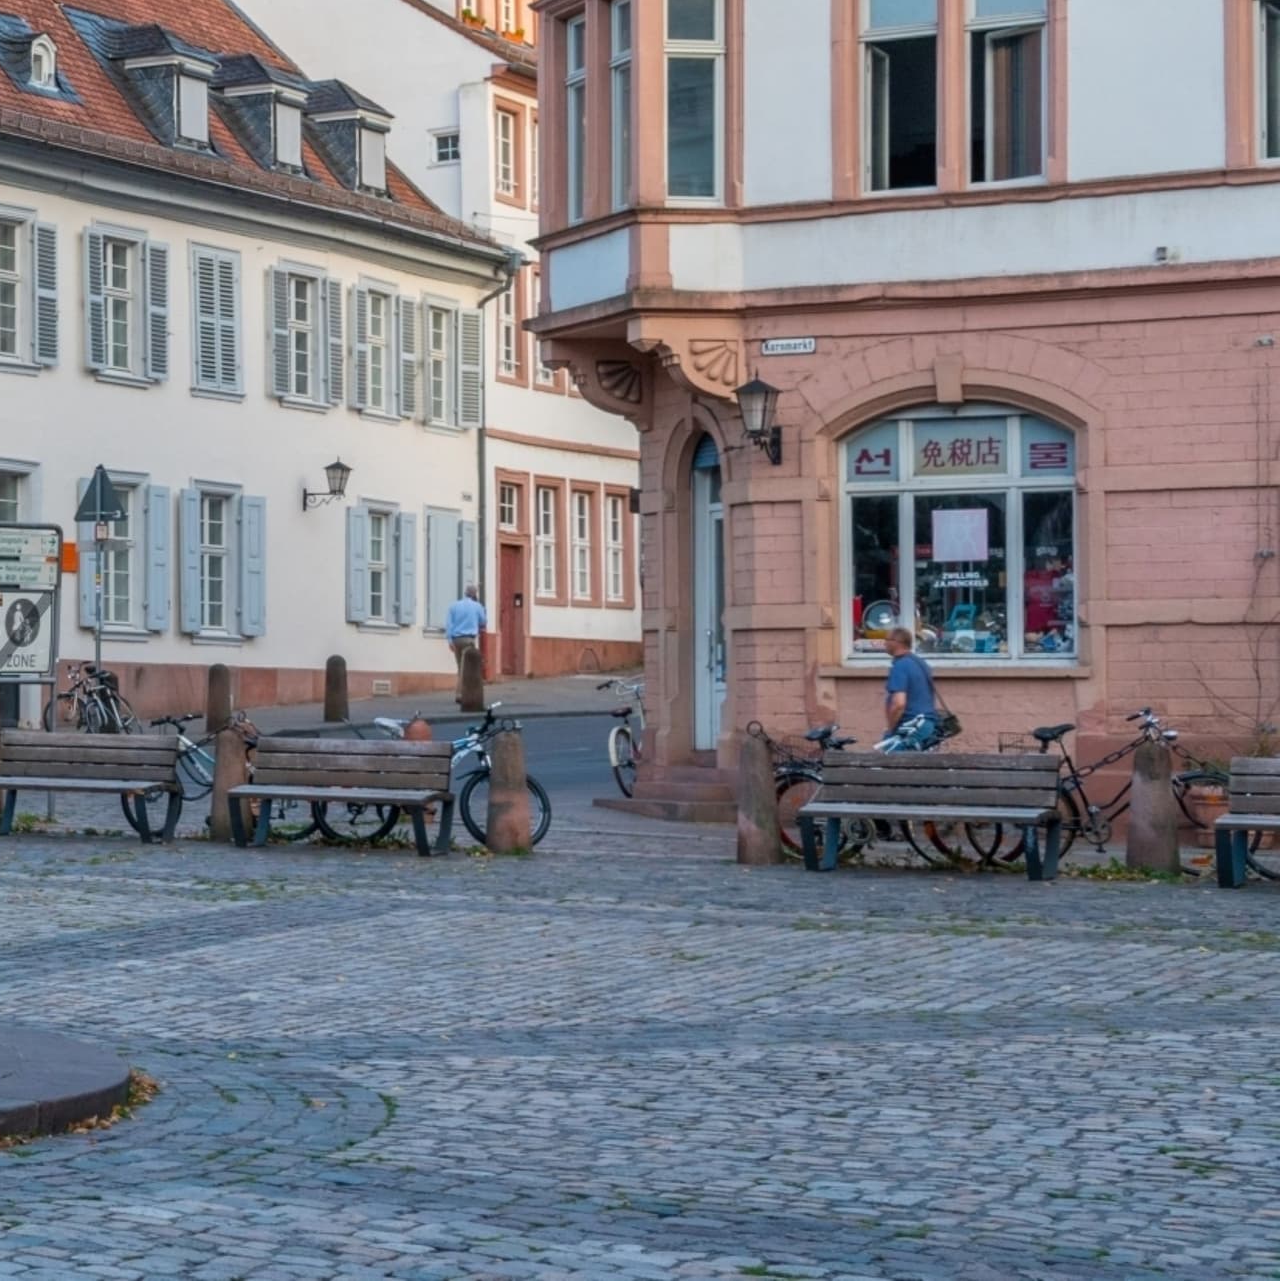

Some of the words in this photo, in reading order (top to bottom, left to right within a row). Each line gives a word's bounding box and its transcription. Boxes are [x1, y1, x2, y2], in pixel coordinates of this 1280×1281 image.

[855, 448, 890, 475] 선
[920, 436, 1003, 468] 免税店
[6, 654, 37, 668] ZONE
